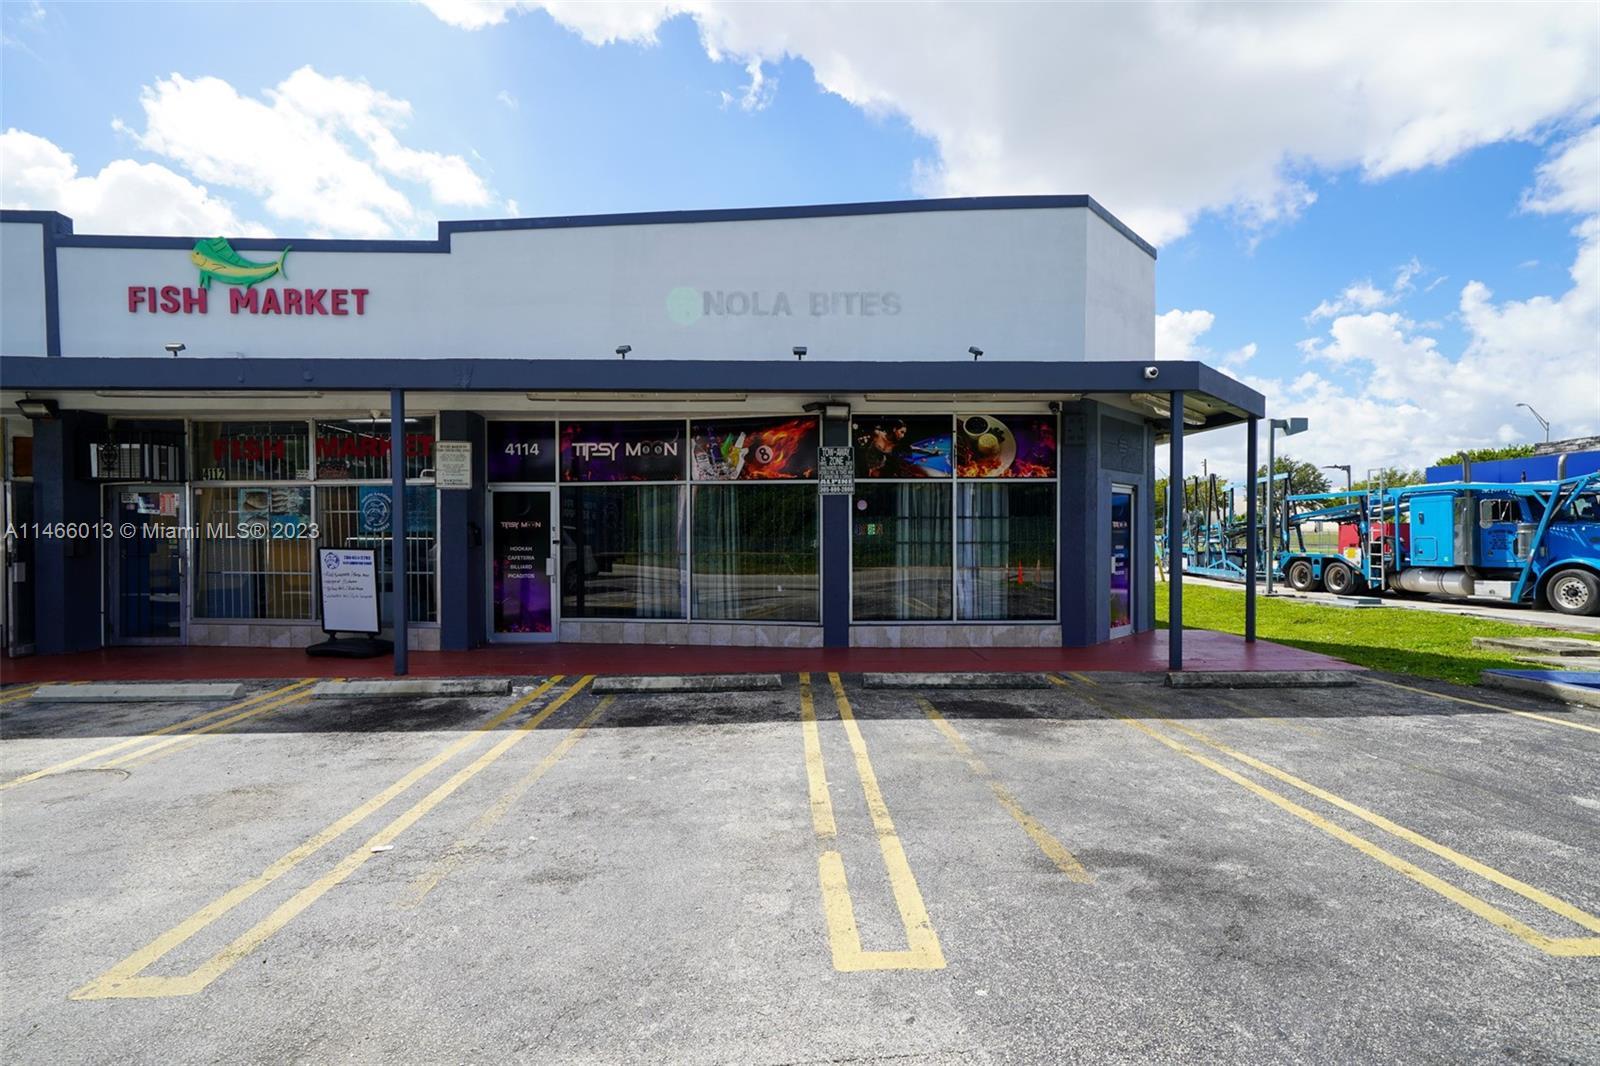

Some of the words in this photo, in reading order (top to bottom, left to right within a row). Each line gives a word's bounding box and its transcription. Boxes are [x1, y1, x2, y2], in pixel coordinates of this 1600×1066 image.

[128, 286, 208, 314] FISH
[229, 287, 369, 315] MARKET
[703, 290, 793, 316] NOLA
[808, 290, 902, 317] BITES
[212, 436, 285, 462] FISH
[505, 442, 540, 456] 4114
[571, 442, 620, 461] TIPSY
[828, 456, 845, 466] ZONE
[203, 467, 225, 480] 4112
